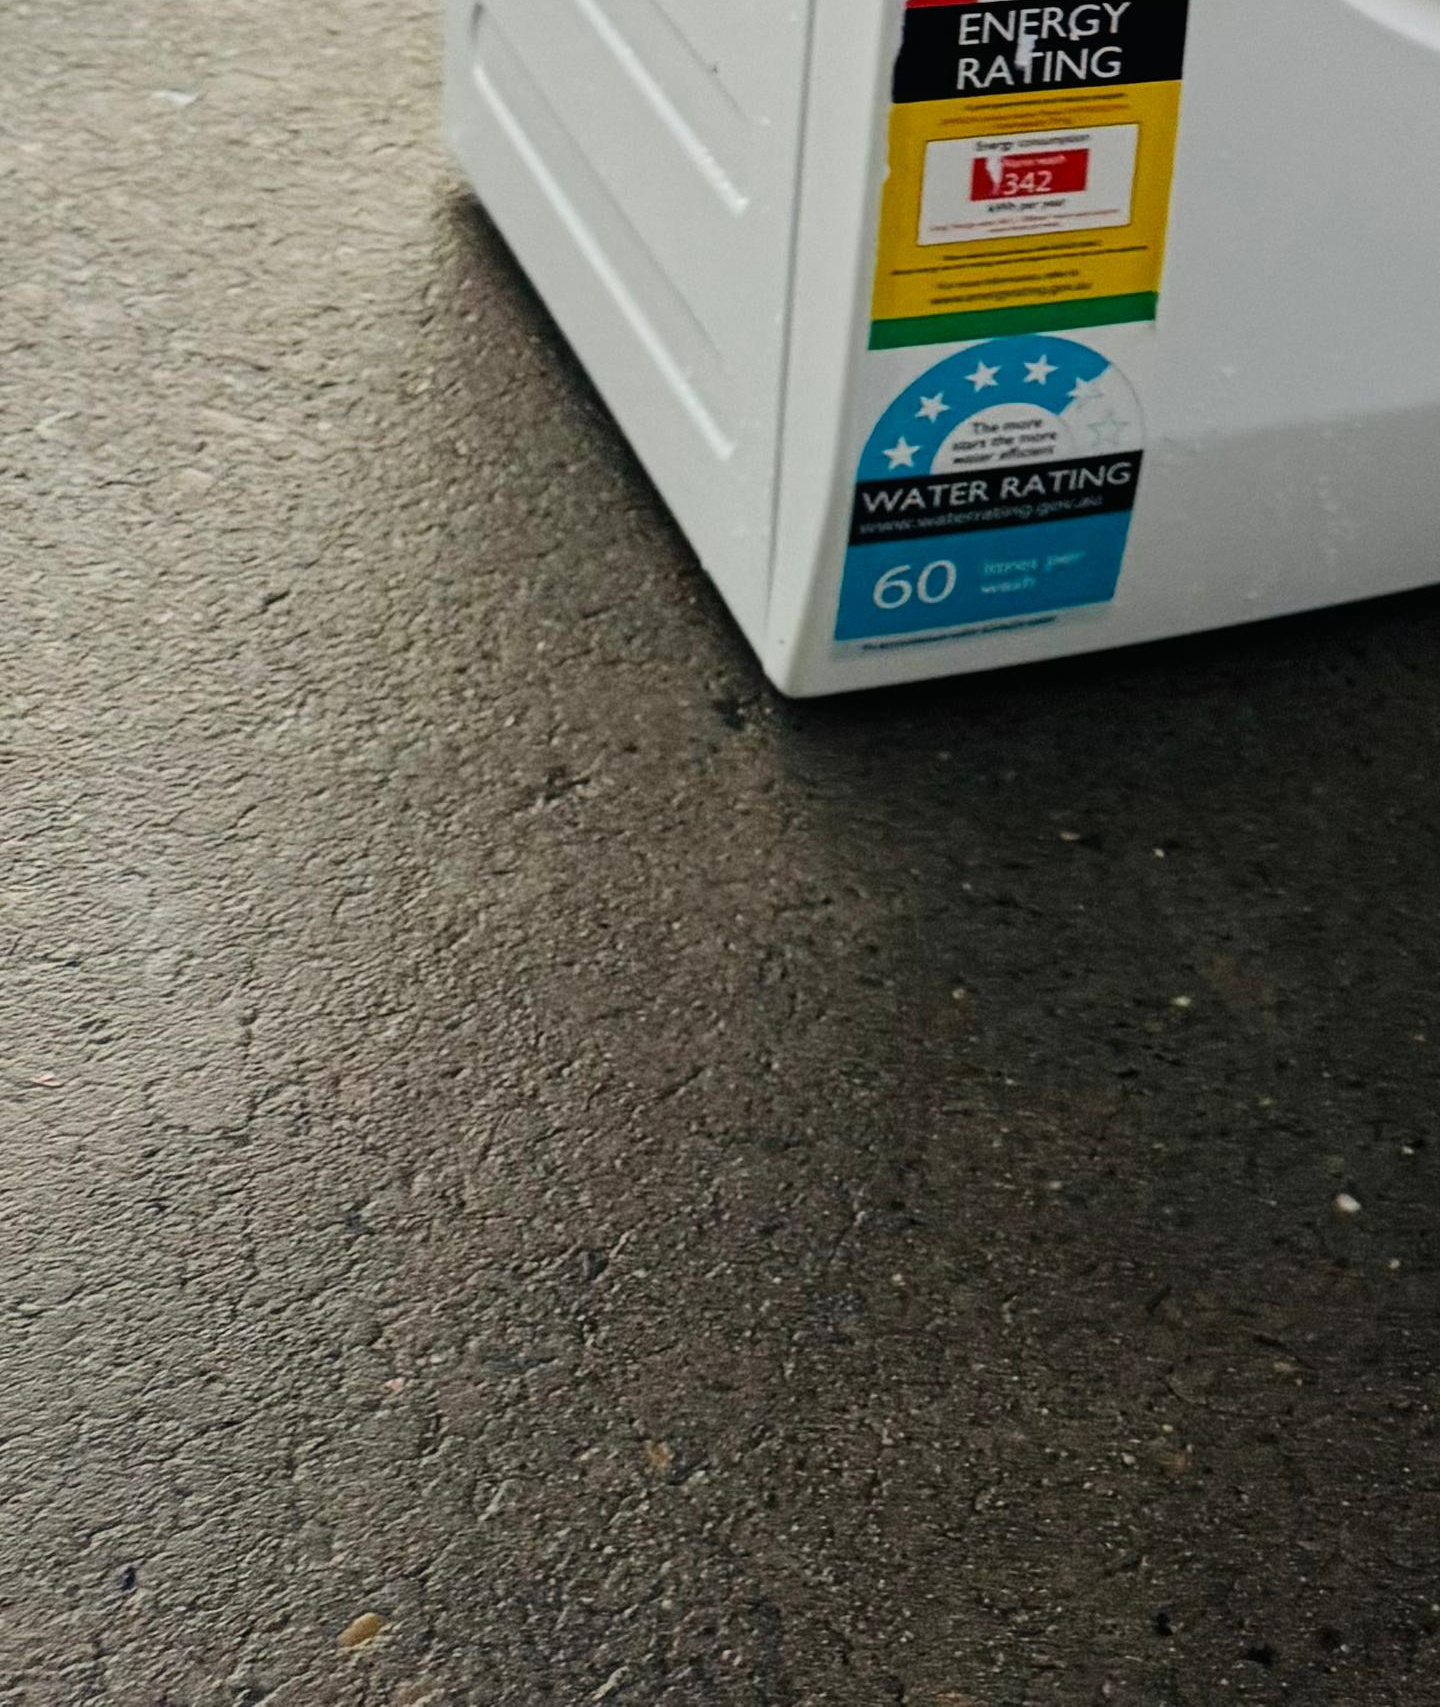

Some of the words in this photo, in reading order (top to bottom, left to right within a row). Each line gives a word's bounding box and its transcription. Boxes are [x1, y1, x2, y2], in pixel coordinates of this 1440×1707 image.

[957, 1, 1132, 47] ENERGY
[956, 45, 1123, 91] RATING
[1002, 170, 1054, 196] 342
[972, 421, 999, 434] The
[1003, 419, 1043, 430] more
[861, 480, 989, 513] WATER
[999, 462, 1132, 500] RATING
[872, 559, 958, 610] 60
